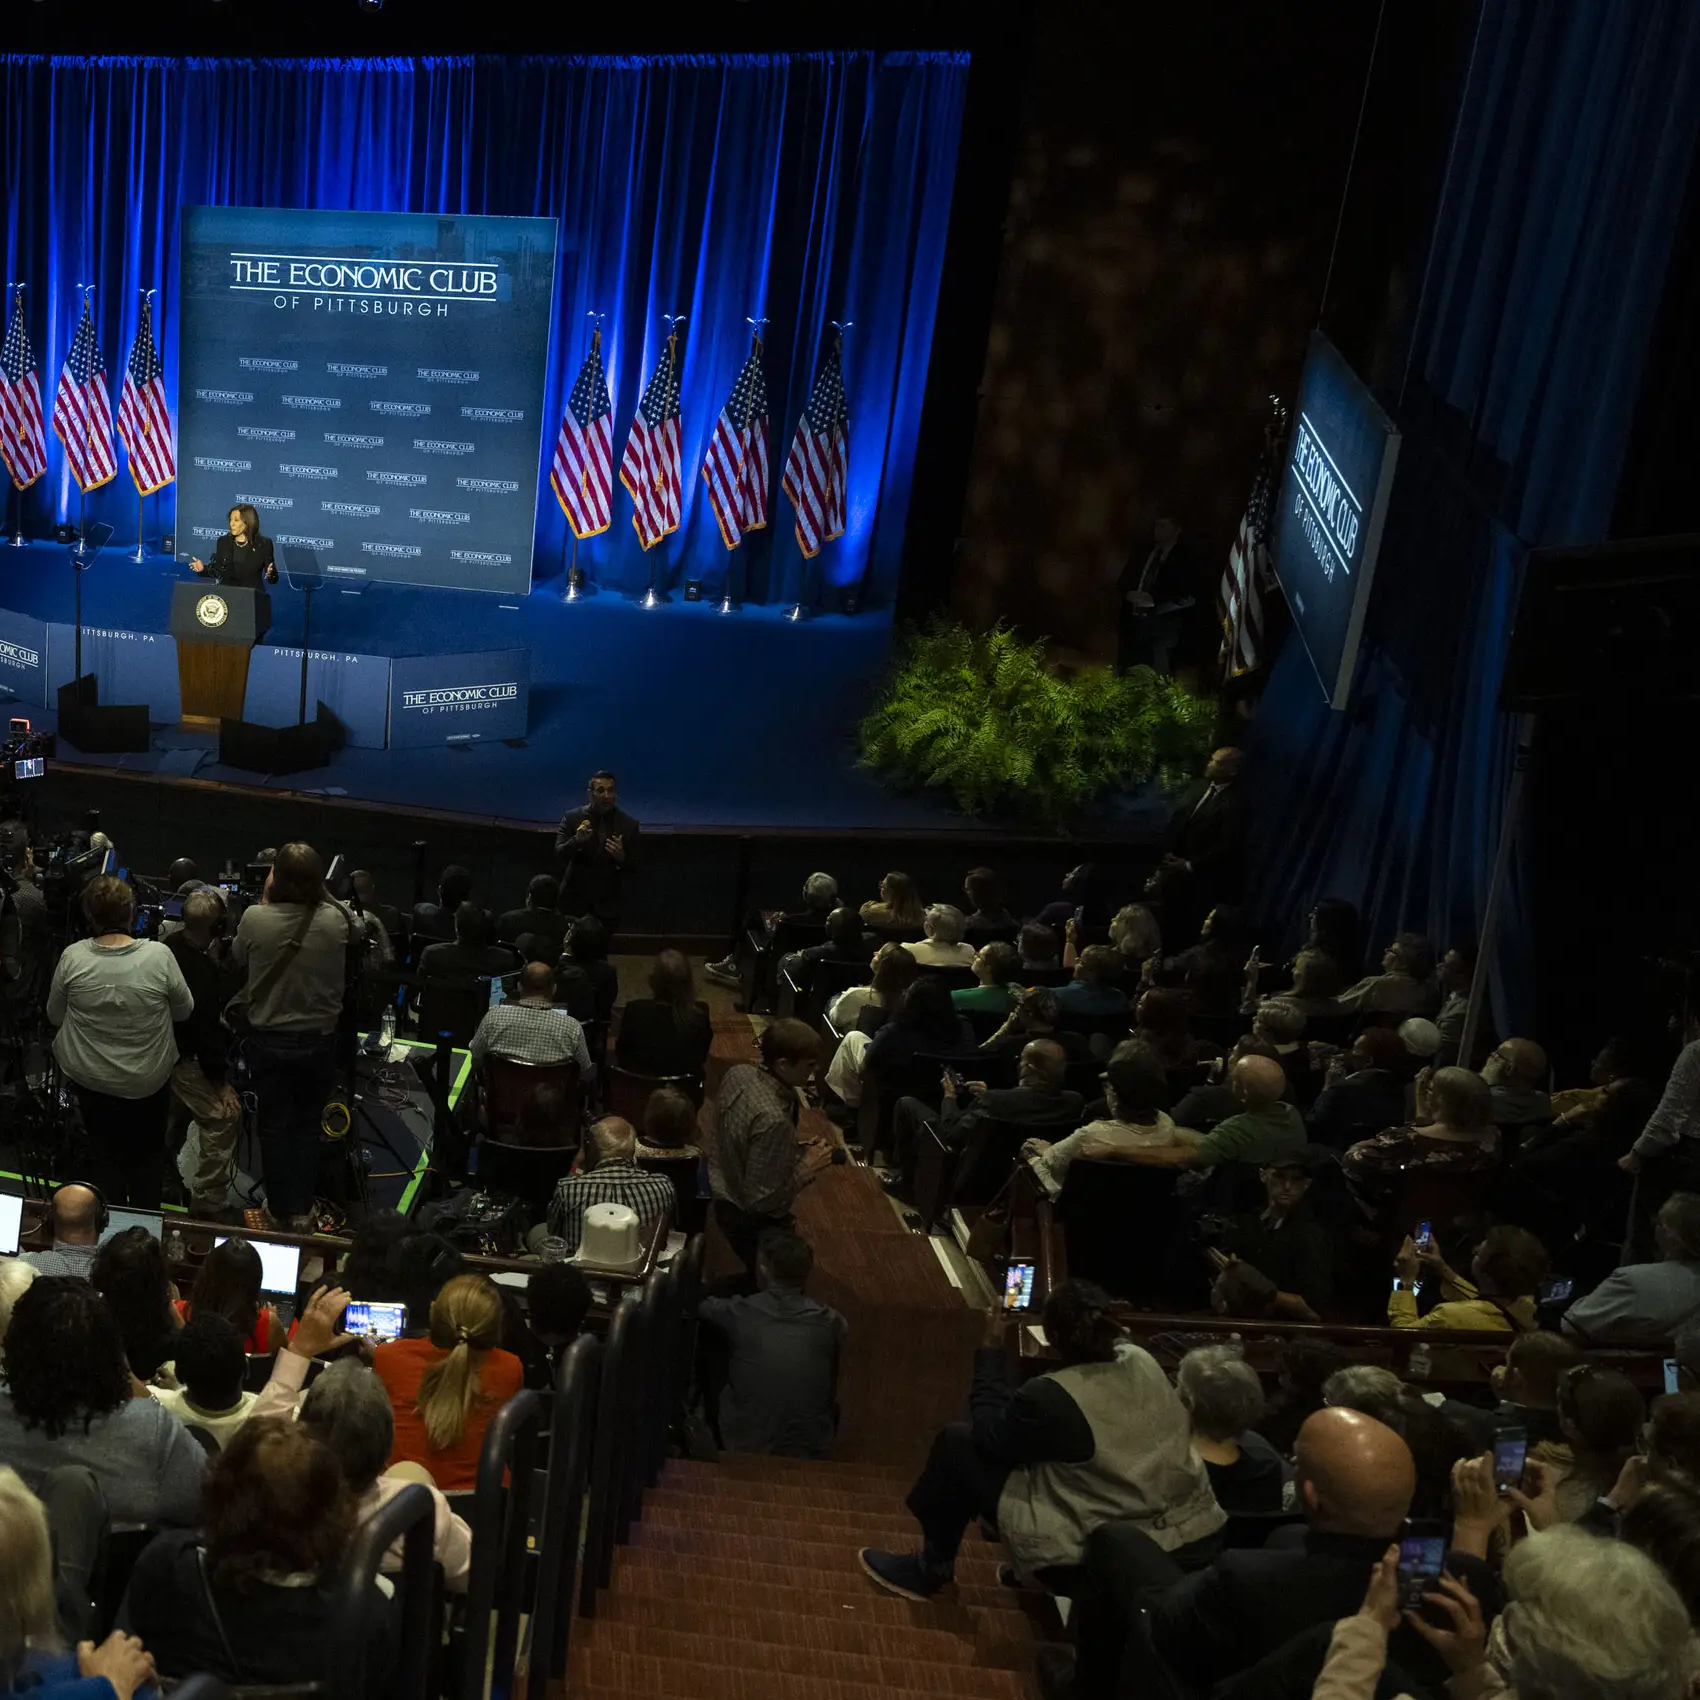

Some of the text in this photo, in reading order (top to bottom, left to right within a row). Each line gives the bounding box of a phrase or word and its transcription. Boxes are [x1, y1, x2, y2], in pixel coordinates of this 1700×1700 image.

[230, 260, 497, 294] THE ECONOMIC CLUB
[274, 296, 448, 316] OF PITTSBURGH
[1294, 424, 1359, 558] THE ECONOMIC CLUB
[289, 537, 318, 545] ECONOMIC
[1294, 494, 1335, 584] OF PITTSBURGH
[82, 628, 138, 641] ITTSBURGH,
[19, 650, 38, 664] CLUB
[404, 685, 517, 705] THE ECONOMIC CLUB
[440, 702, 497, 712] PITTSBURGH
